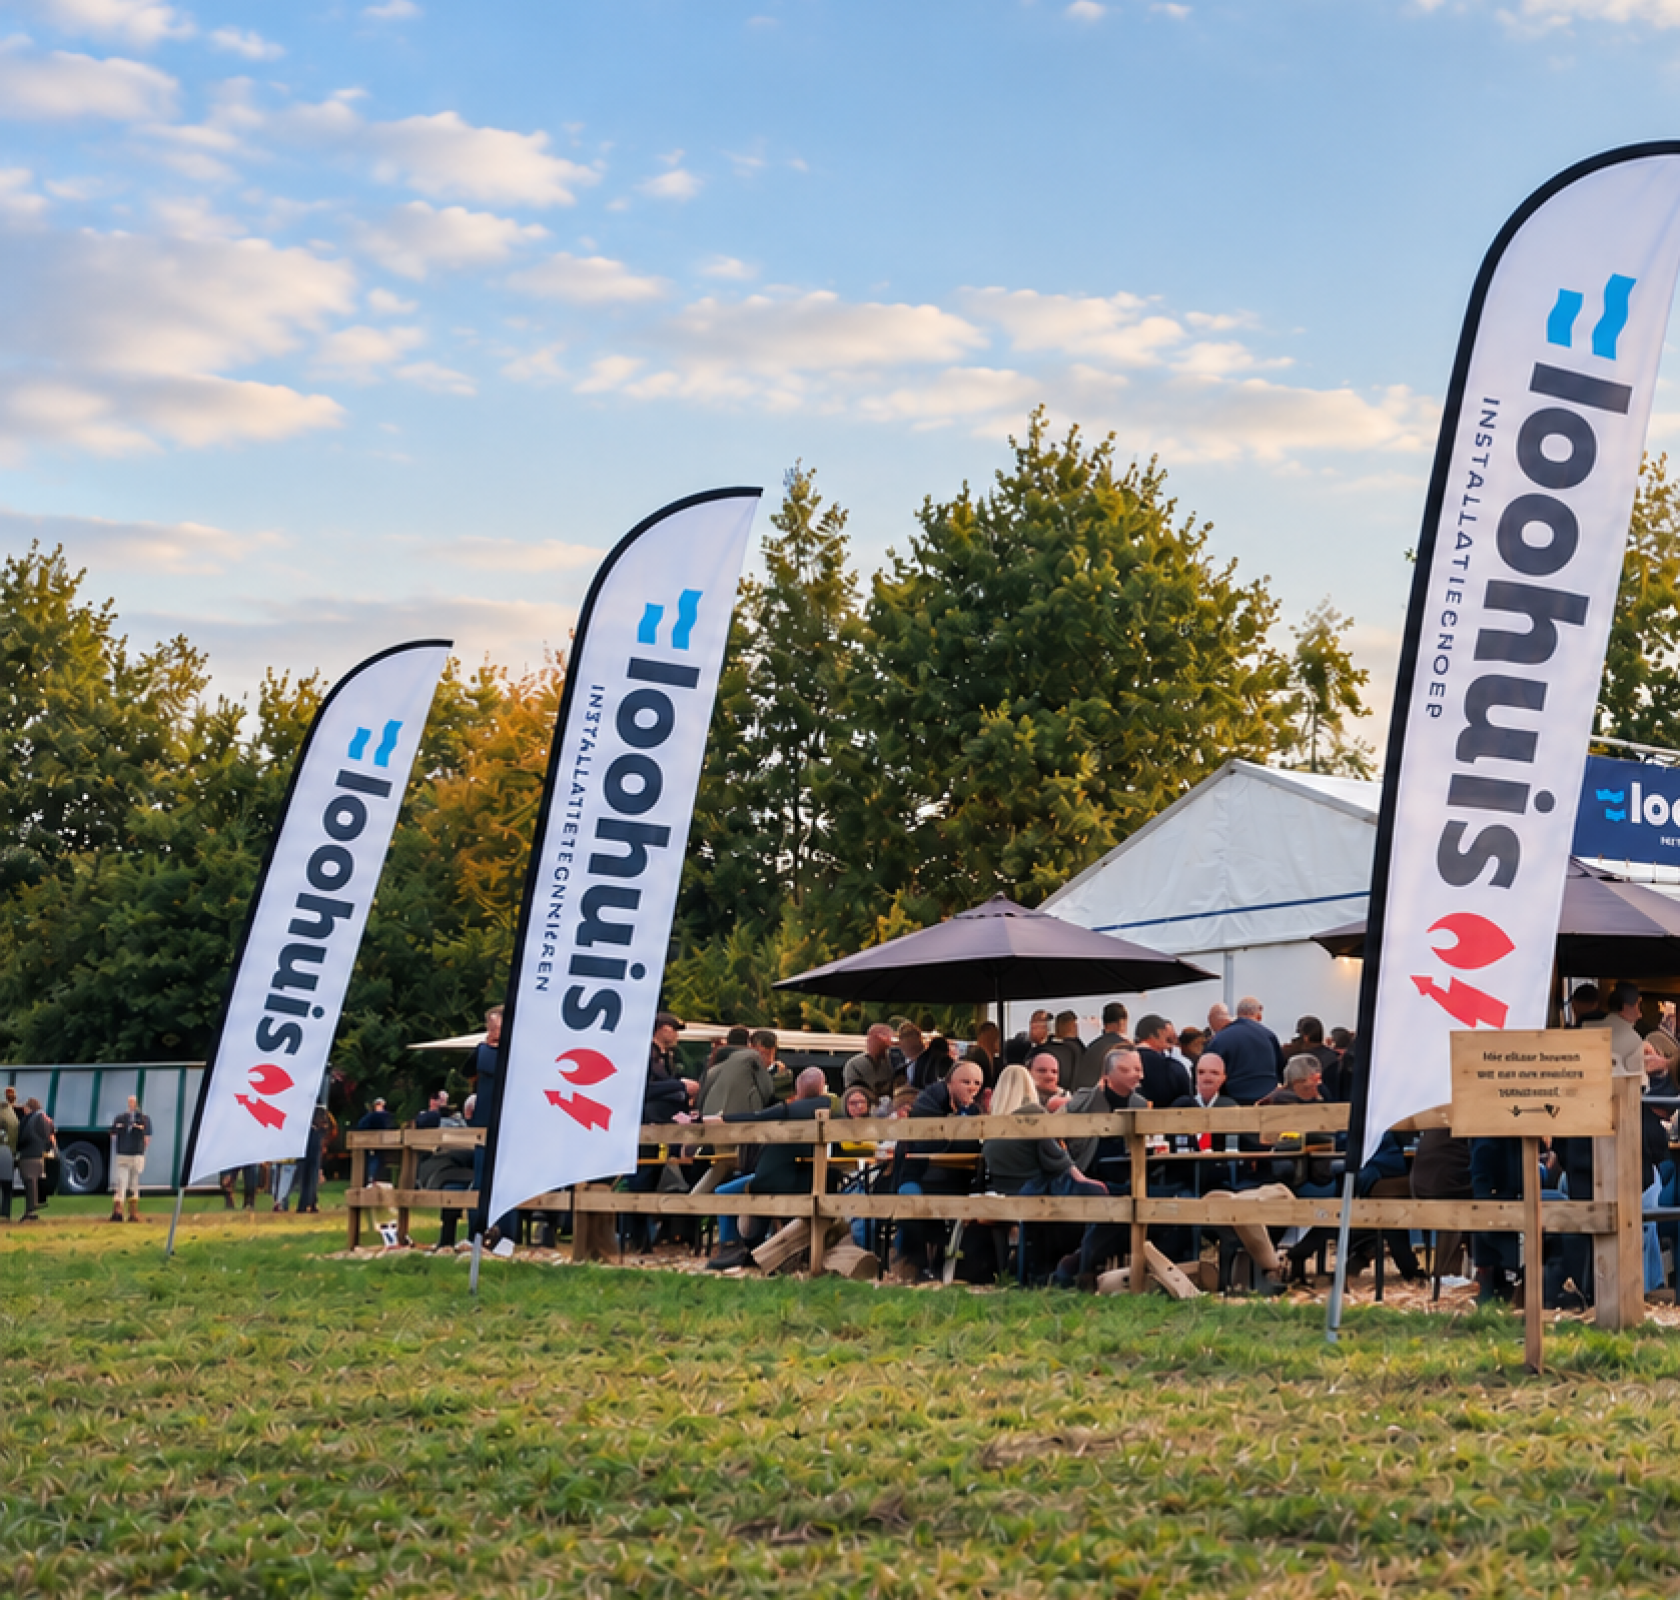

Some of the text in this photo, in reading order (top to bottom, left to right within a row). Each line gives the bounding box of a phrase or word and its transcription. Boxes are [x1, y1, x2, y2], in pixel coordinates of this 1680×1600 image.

[1437, 362, 1633, 890] loohuis
[255, 768, 393, 1056] loohuis
[561, 656, 701, 1033] loohuis
